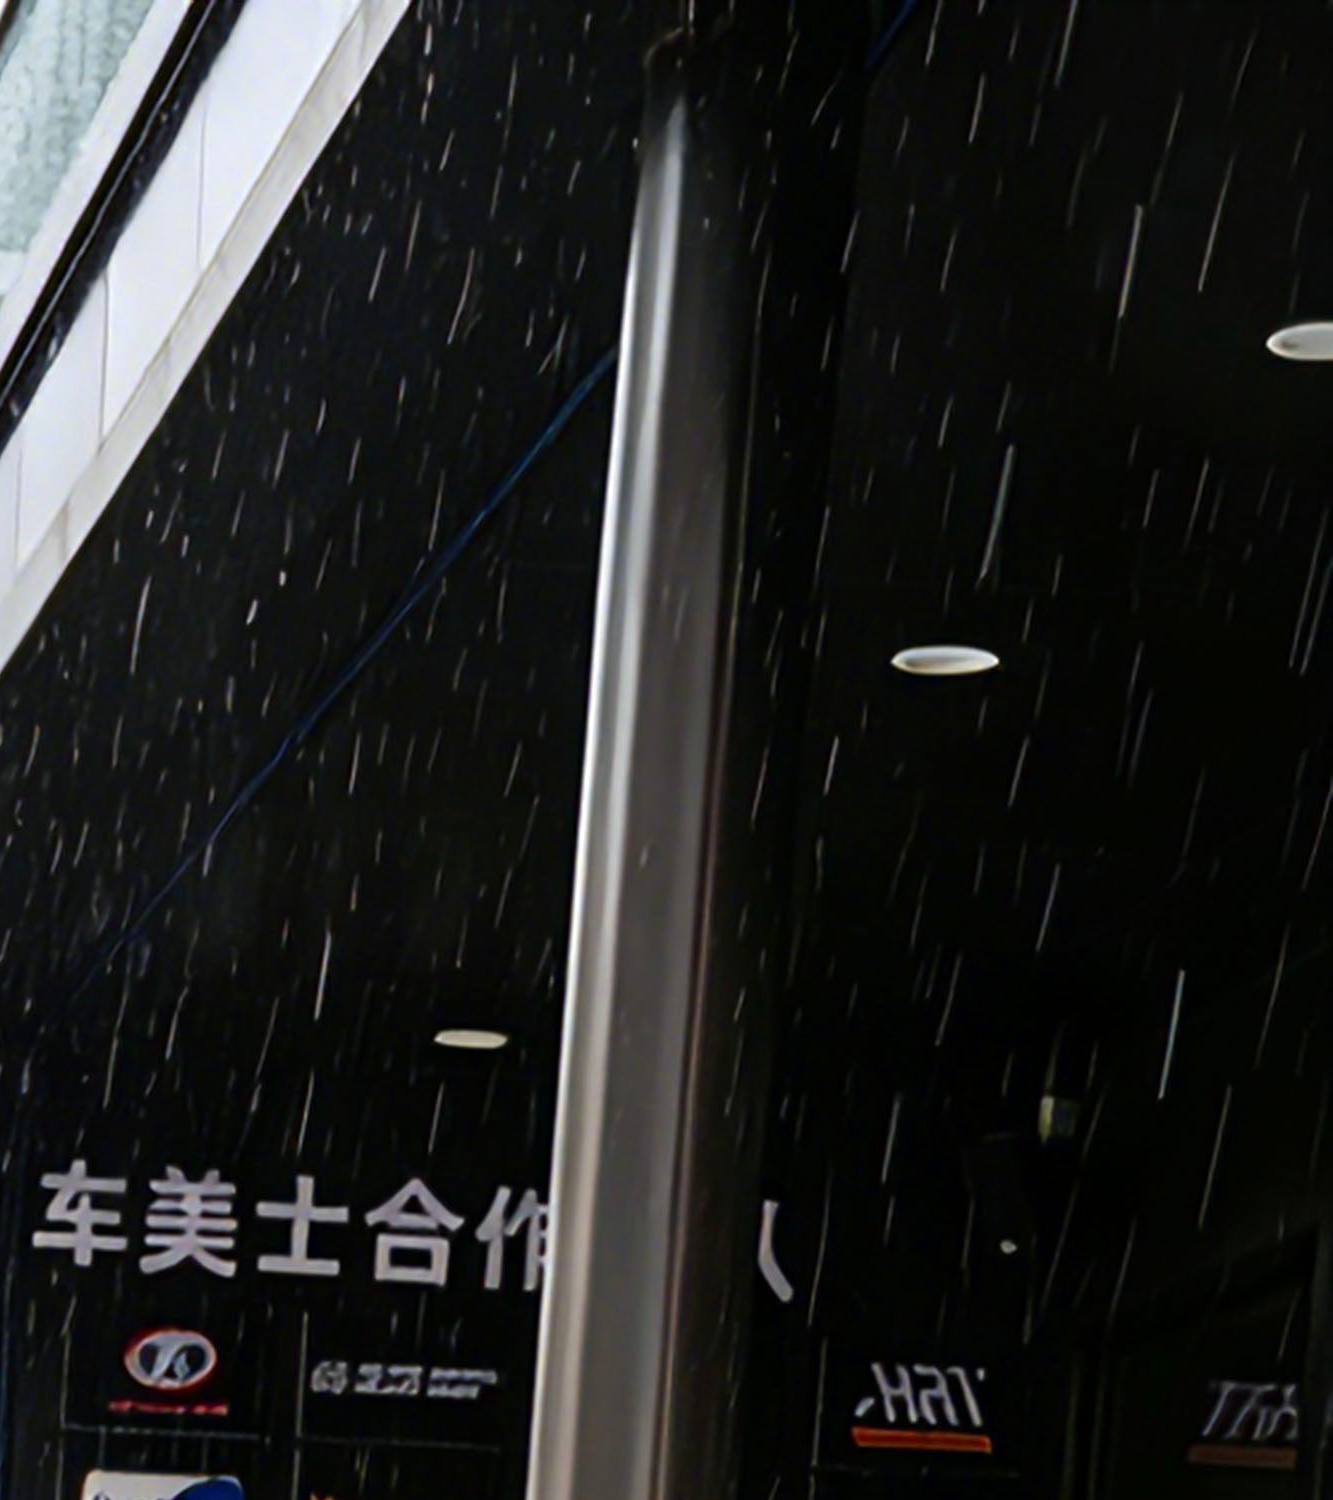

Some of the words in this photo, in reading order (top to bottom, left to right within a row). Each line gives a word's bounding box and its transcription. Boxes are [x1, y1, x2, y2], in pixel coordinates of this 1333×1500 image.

[32, 1158, 550, 1292] 车美士合作
